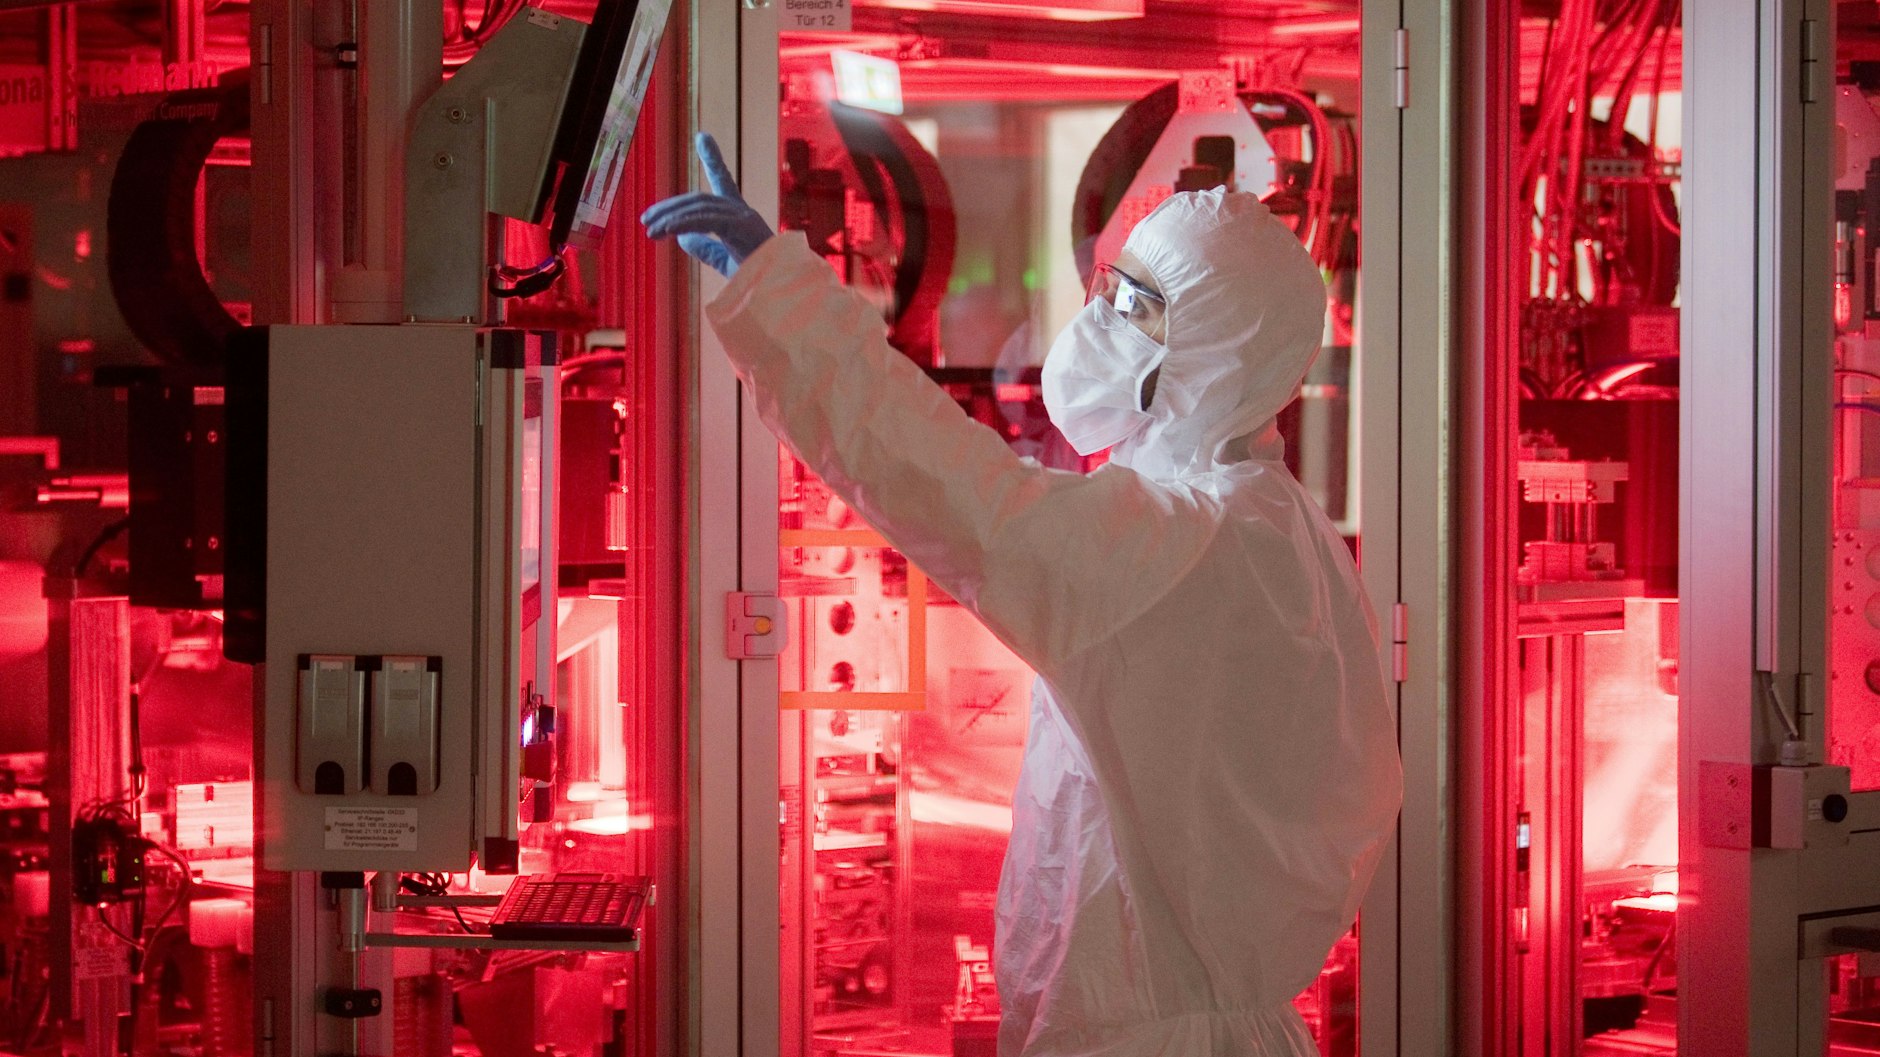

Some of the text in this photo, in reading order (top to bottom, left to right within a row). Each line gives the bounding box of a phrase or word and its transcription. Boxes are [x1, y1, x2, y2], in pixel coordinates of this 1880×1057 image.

[786, 0, 843, 9] Bereich 4
[795, 15, 834, 26] Tür 12
